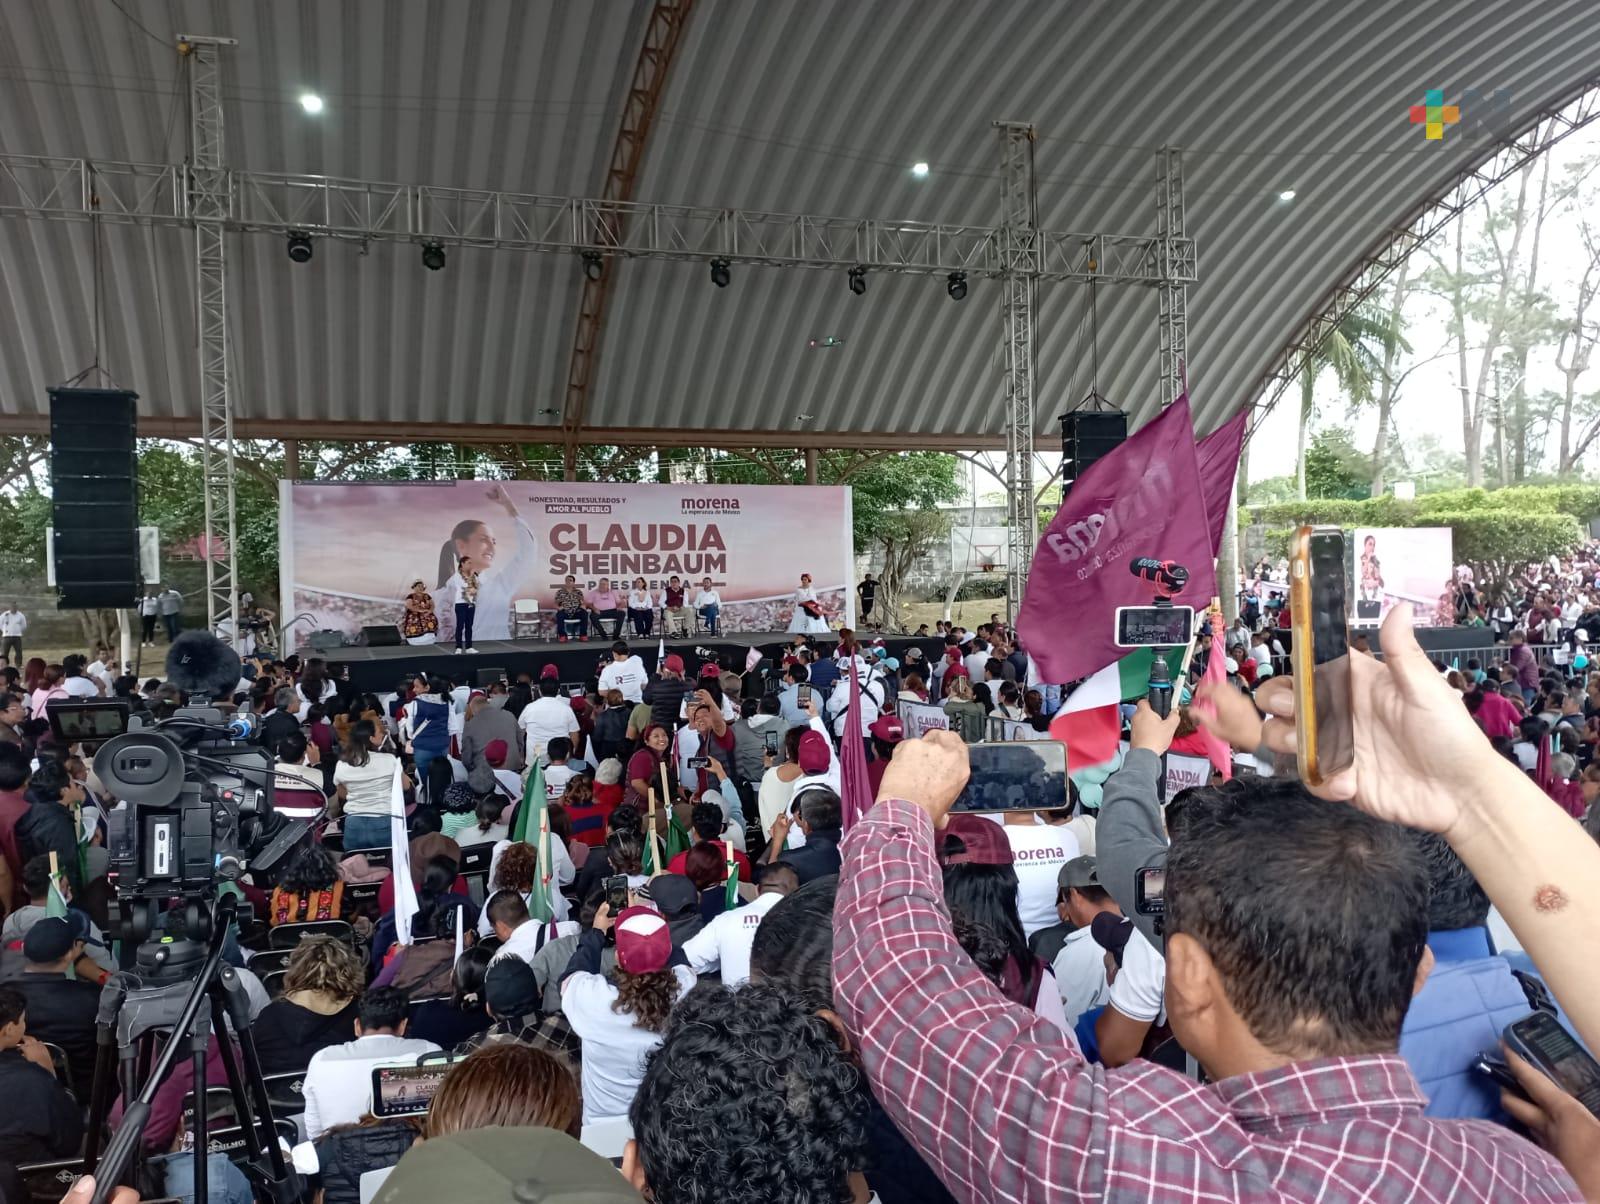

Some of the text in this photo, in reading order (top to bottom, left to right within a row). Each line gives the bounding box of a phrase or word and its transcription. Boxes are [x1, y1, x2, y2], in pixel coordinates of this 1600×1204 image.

[528, 496, 576, 505] HONESTIDAD,
[681, 498, 740, 509] morena
[547, 505, 571, 513] AMOR
[549, 523, 726, 551] CLAUDIA
[549, 553, 727, 575] SHEINBAUM
[1167, 768, 1200, 785] AUDIA
